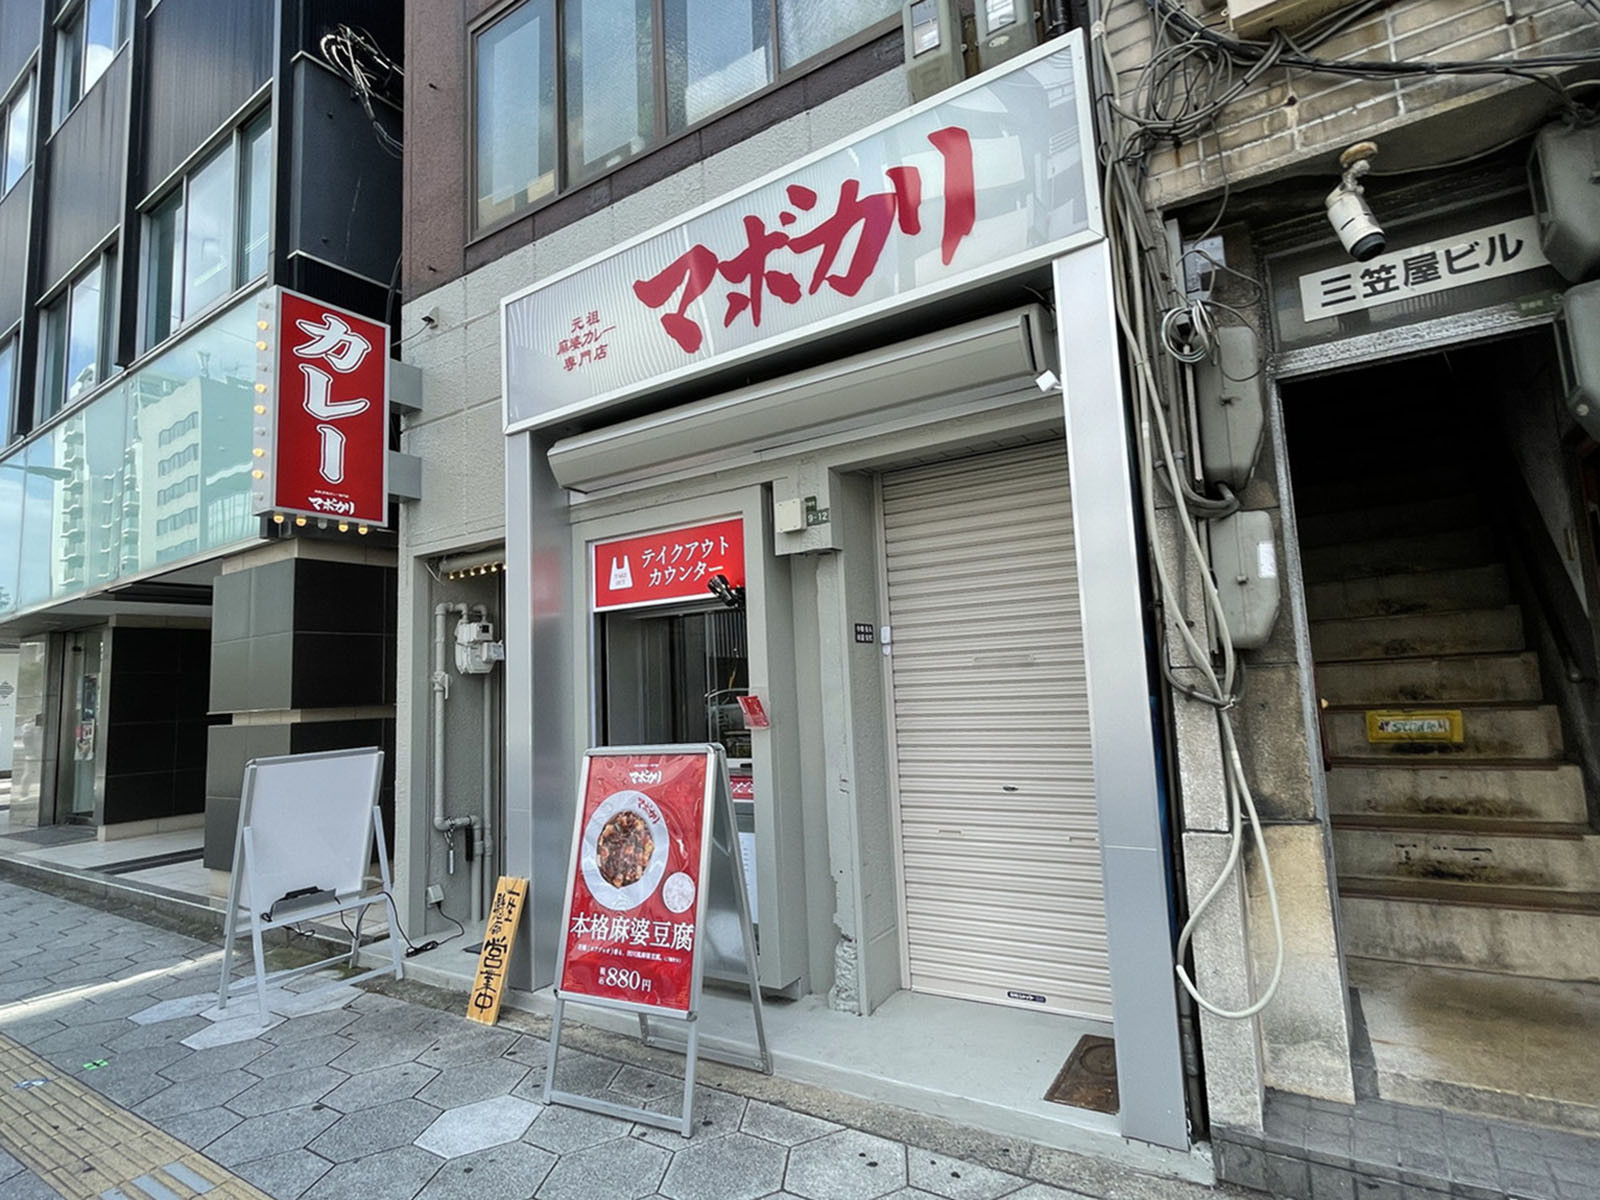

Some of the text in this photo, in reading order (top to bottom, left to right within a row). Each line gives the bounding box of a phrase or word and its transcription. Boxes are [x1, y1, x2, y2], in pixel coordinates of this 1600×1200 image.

[632, 125, 976, 355] マボカリ
[1320, 232, 1524, 309] 三笠屋ビル
[571, 310, 600, 333] 元祖
[557, 325, 617, 356] 麻婆カレー
[292, 312, 373, 486] カレー
[640, 536, 730, 568] テイクアウト
[648, 561, 724, 588] カウンター
[569, 911, 695, 952] 本格麻婆豆腐
